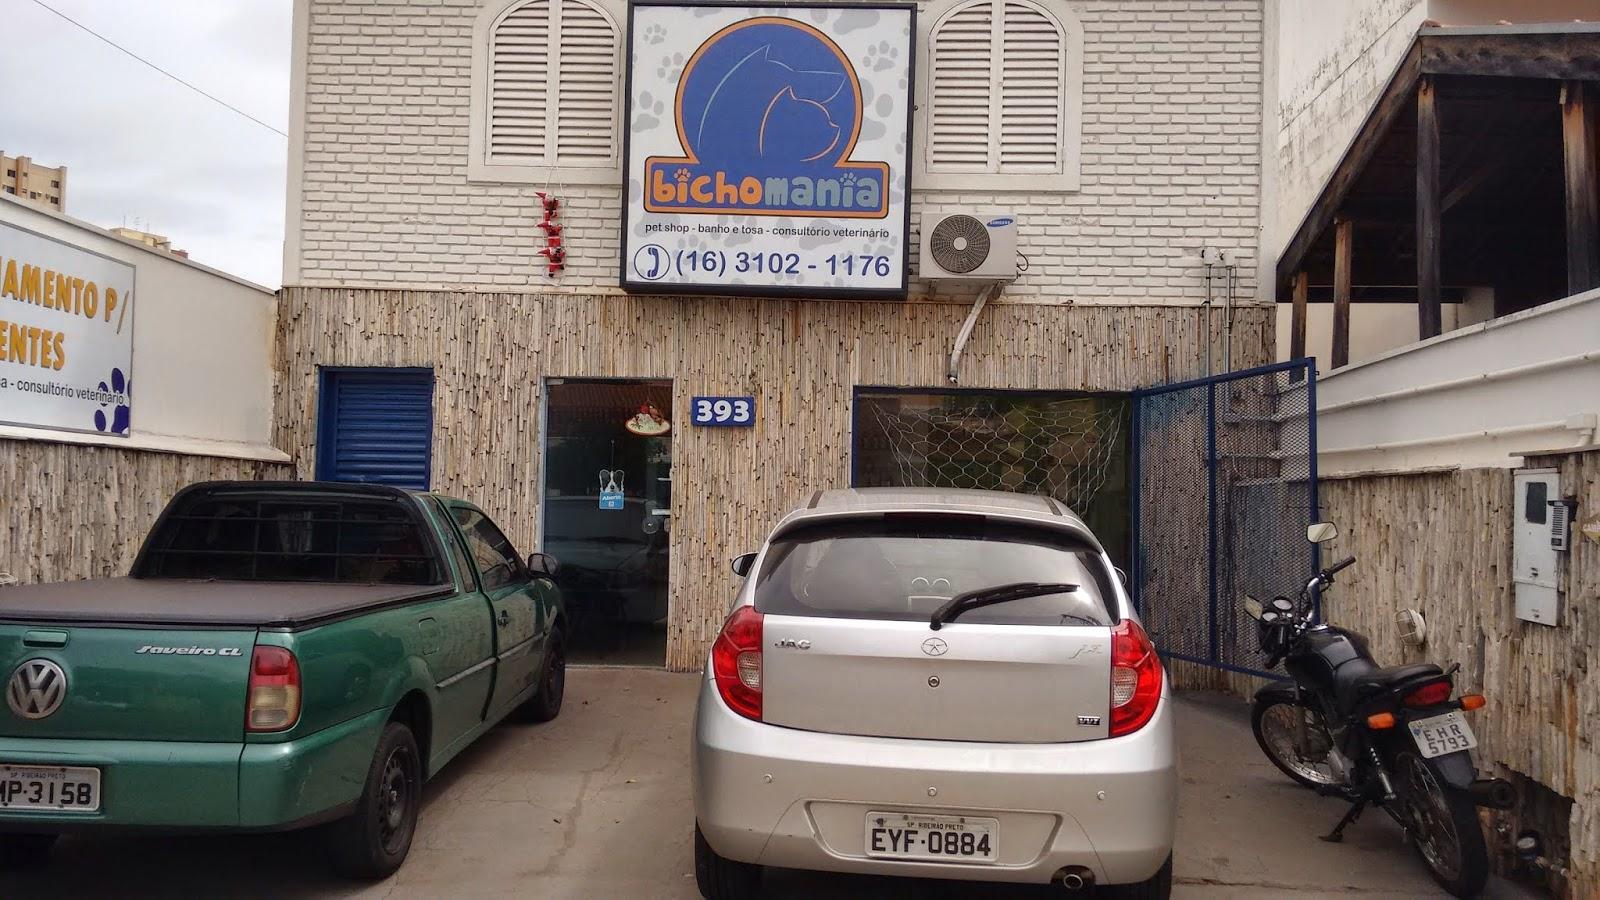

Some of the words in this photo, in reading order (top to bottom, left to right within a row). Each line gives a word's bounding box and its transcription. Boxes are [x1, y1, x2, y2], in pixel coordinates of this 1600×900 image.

[653, 168, 880, 208] bichomania
[645, 222, 662, 233] pet
[664, 223, 690, 234] shop
[698, 224, 730, 234] banho
[732, 226, 739, 234] e
[741, 226, 764, 235] tosa
[772, 227, 831, 237] consultório
[833, 228, 890, 238] veterinário
[676, 249, 726, 277] (16)
[735, 251, 800, 274] 3102
[825, 254, 890, 277] 1176
[17, 380, 74, 398] consultório
[76, 387, 124, 405] veterinário
[696, 400, 750, 423] 393
[136, 645, 217, 655] Saveiro
[218, 647, 243, 656] CL
[774, 638, 811, 650] JAC
[1423, 724, 1461, 742] EHR
[1428, 735, 1469, 754] 5793
